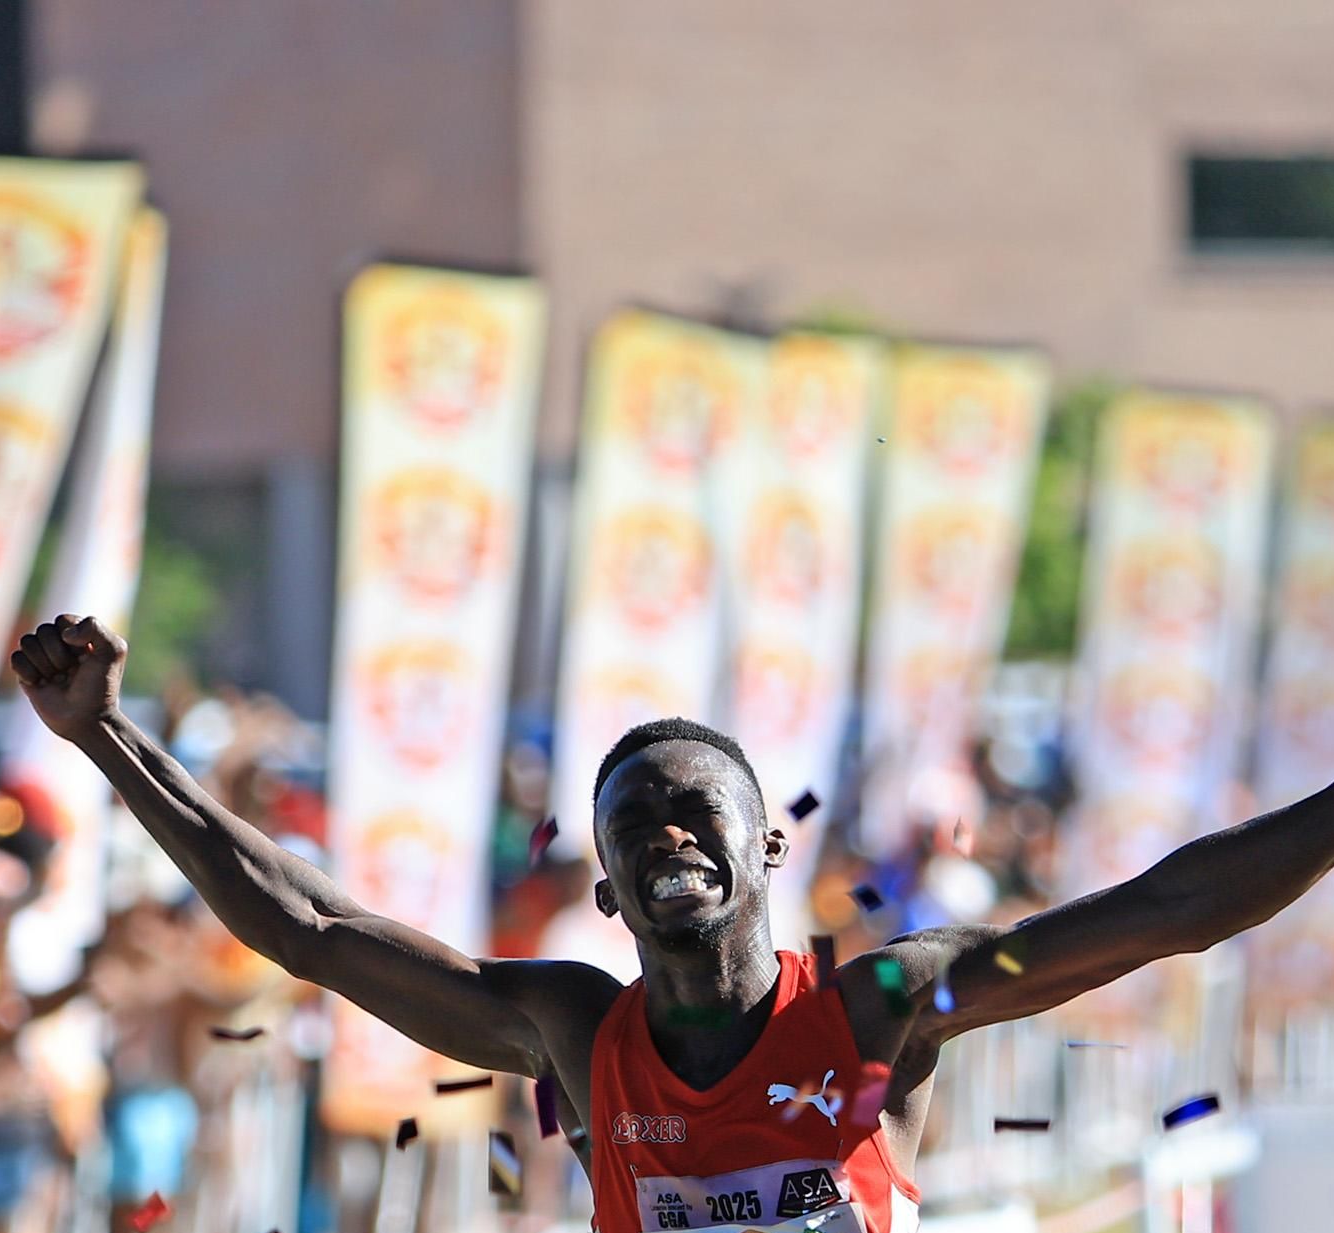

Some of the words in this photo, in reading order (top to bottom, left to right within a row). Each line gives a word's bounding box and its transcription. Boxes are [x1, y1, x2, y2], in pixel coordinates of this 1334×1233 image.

[612, 1112, 686, 1144] BOXER
[657, 1193, 683, 1204] ASA
[784, 1173, 834, 1201] ASA
[658, 1211, 691, 1228] CGA
[706, 1189, 762, 1222] 2025
